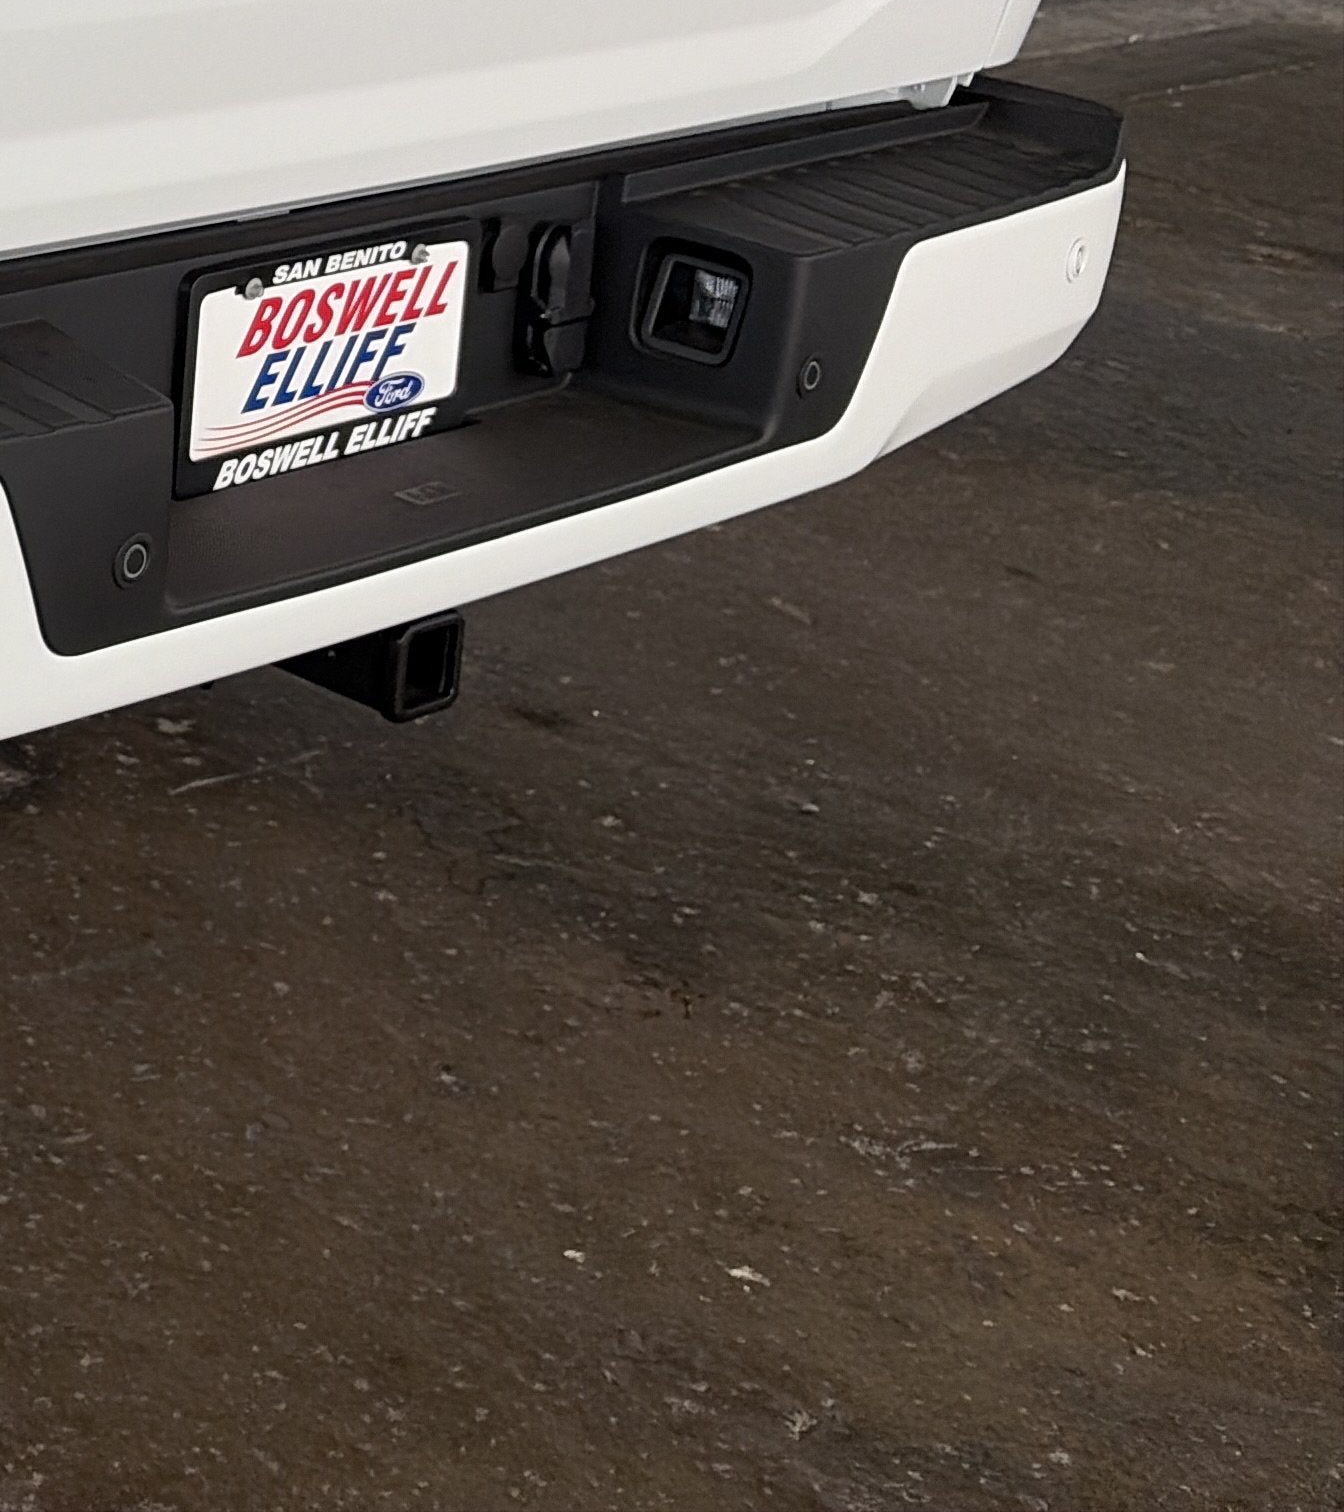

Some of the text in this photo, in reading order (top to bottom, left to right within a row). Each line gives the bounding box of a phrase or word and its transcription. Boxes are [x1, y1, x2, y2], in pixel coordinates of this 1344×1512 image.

[272, 241, 407, 285] SAN BENITO
[236, 261, 459, 359] BOSWELL
[241, 323, 417, 414] ELLIFF
[375, 381, 412, 408] Ford
[213, 407, 438, 491] BOSWELL ELLIFF
